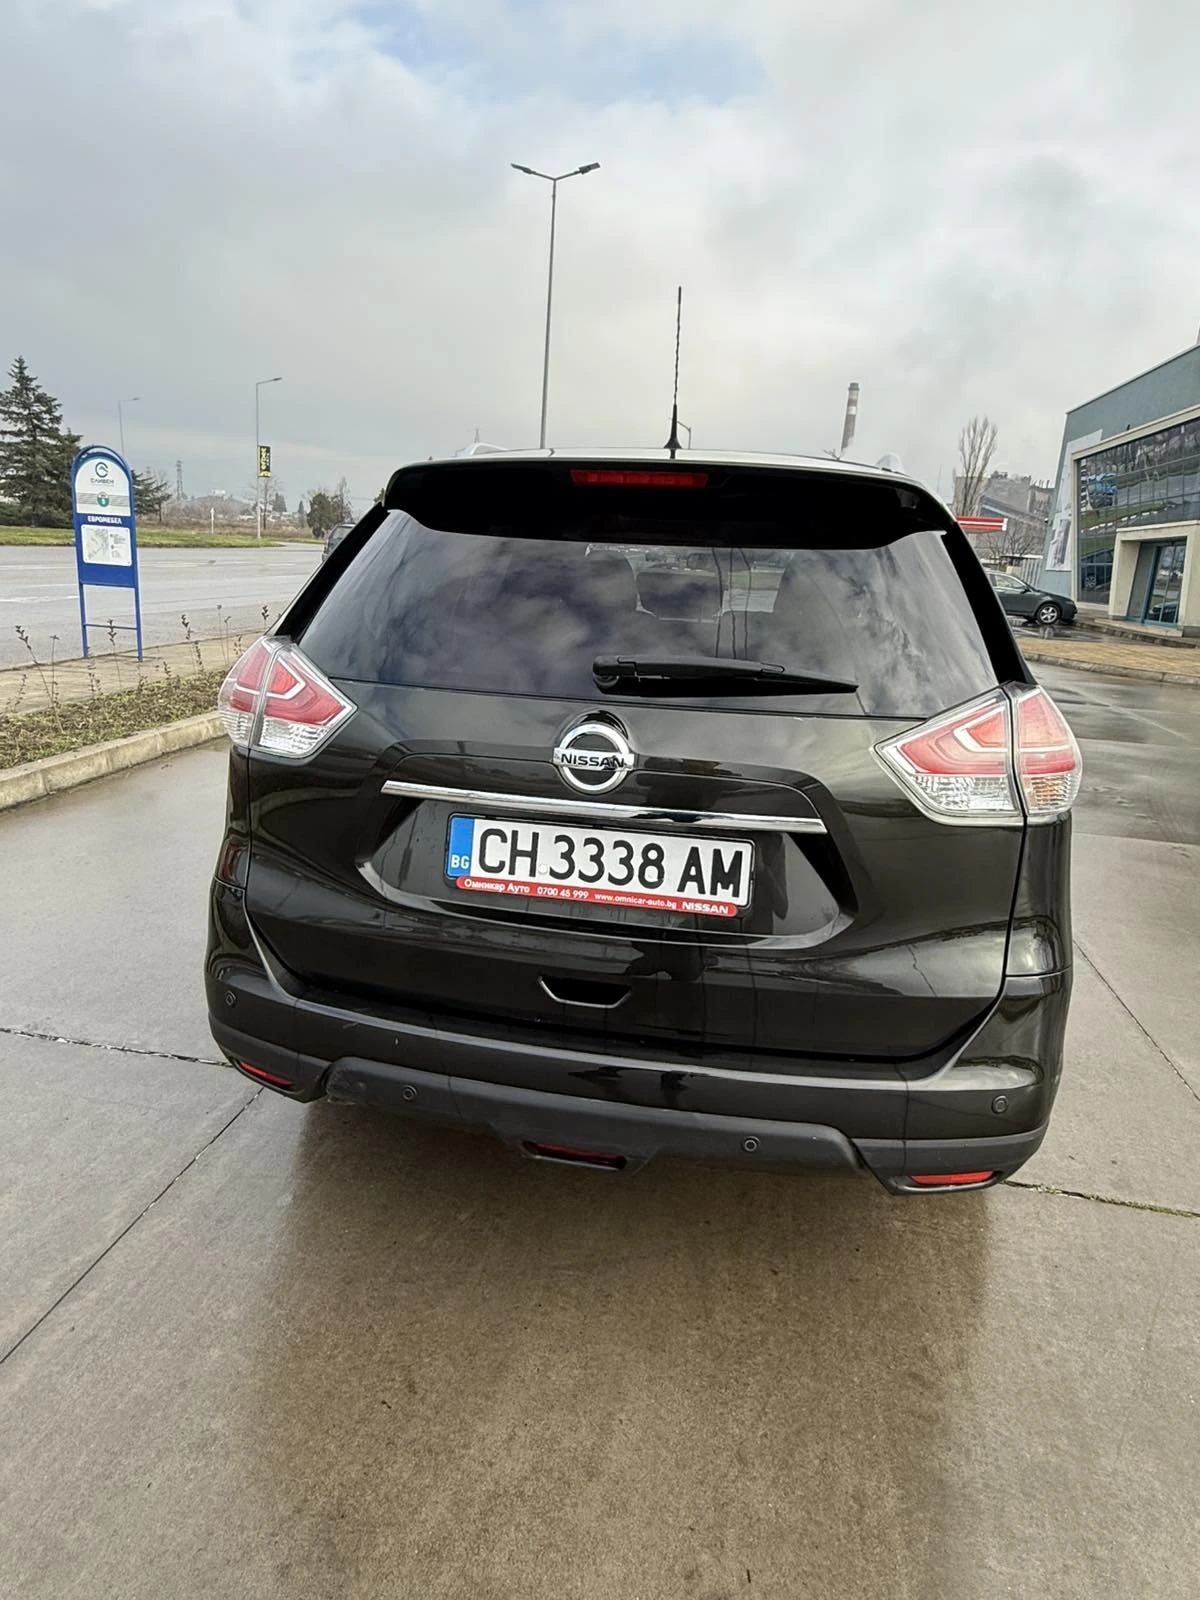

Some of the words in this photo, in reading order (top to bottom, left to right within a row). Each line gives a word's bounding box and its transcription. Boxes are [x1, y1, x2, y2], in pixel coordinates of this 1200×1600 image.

[561, 753, 625, 768] NISSAN
[451, 854, 470, 870] BG
[479, 828, 540, 878] CH
[549, 834, 665, 889] 3338
[677, 846, 743, 899] AM
[464, 878, 505, 893] Омникар
[507, 883, 531, 895] Ауто
[537, 886, 559, 897] 0700
[560, 889, 571, 898] 45
[573, 890, 589, 900] 999
[594, 893, 677, 911] www.omnicar-auto.bg
[682, 901, 729, 915] NISSAN
